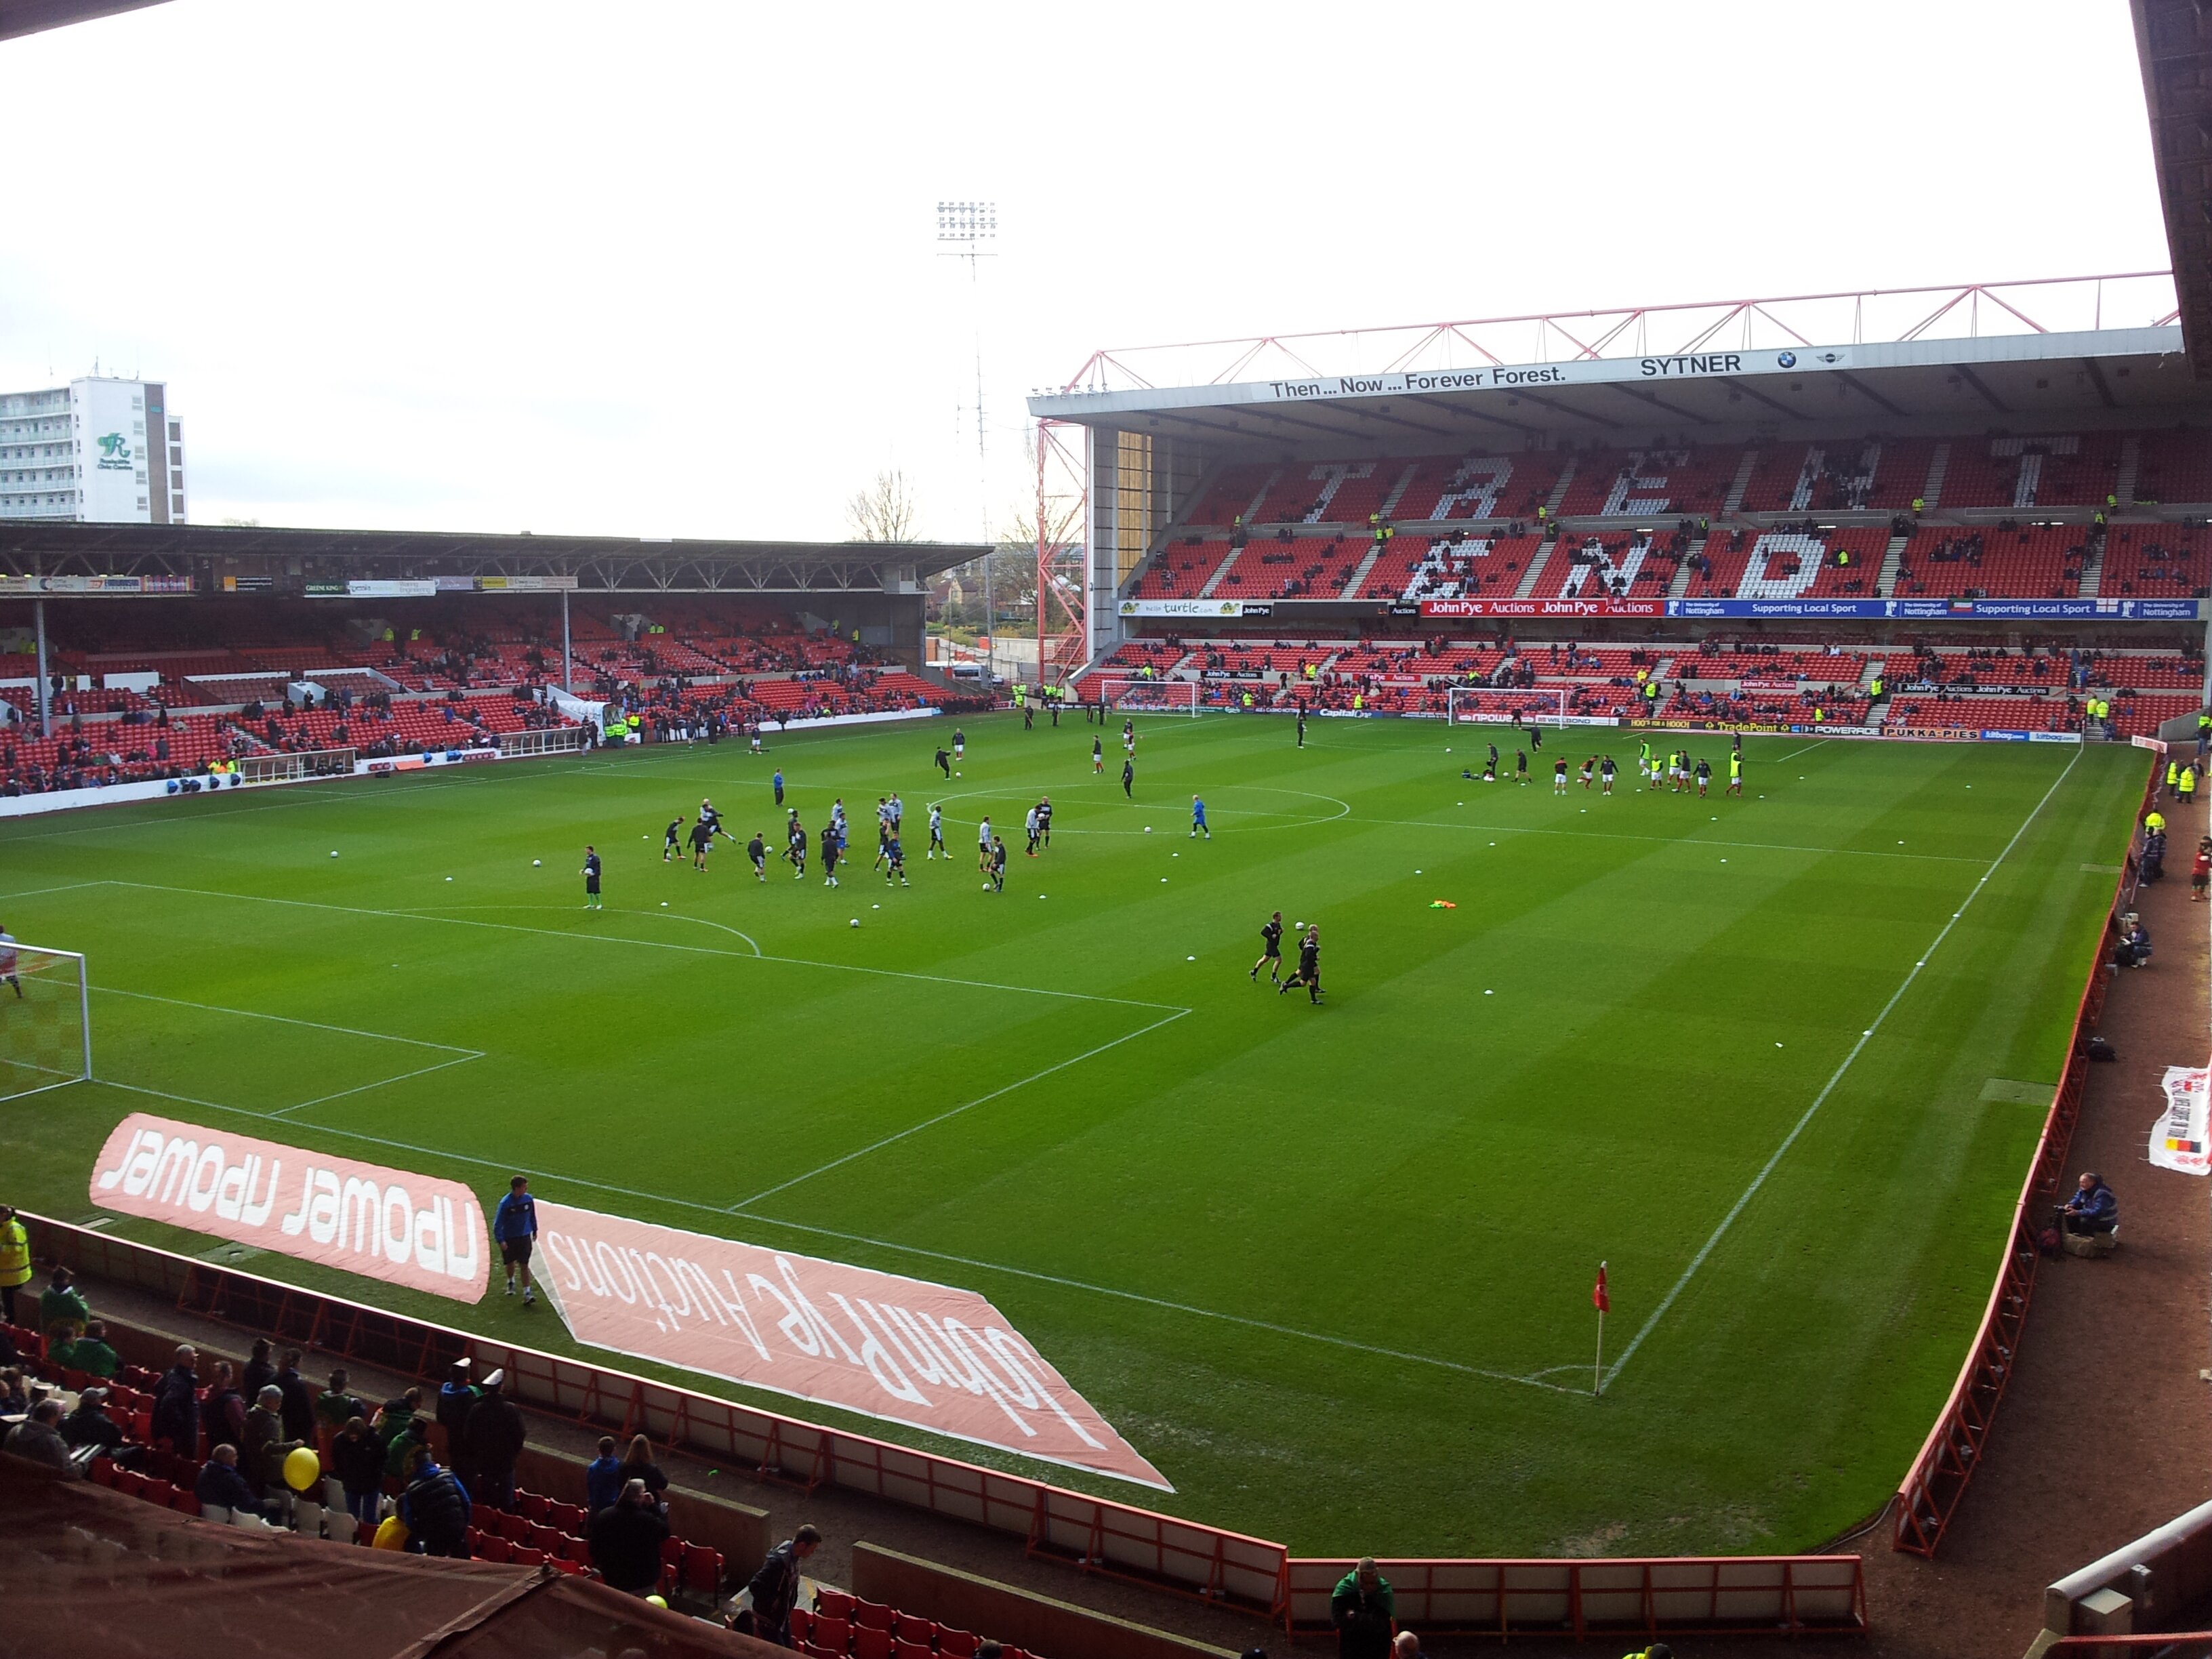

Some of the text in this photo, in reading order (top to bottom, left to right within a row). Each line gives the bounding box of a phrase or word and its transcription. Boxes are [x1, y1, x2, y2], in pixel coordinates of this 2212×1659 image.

[1641, 354, 1742, 377] SYTNER
[1406, 373, 1483, 390] Forever
[1492, 365, 1566, 385] Forest.
[1391, 606, 1416, 615] Auctions
[1429, 601, 1459, 613] John
[1461, 602, 1483, 616] Pye
[1488, 601, 1536, 614] Auctions
[1541, 601, 1572, 613] John
[1574, 602, 1599, 616] Pye
[1685, 607, 1725, 616] Nottingham
[1752, 603, 1857, 615] Supporting Local Sport
[1904, 607, 1948, 617] Nottingham
[1975, 603, 2091, 615] Supporting Local Sport
[2143, 608, 2191, 617] Nottingham
[1997, 686, 2012, 694] Pye
[2016, 686, 2047, 694] Auctions
[1319, 708, 1355, 718] Capital
[1472, 713, 1514, 722] npowe
[1666, 720, 1690, 729] HOOCH
[1717, 721, 1778, 733] TradePoint
[1814, 725, 1881, 735] POWERADE
[1985, 731, 2025, 740] kitbag.com
[2035, 733, 2075, 741] kitbag.com
[97, 1128, 281, 1227] npower
[281, 1166, 478, 1281] npower
[547, 1230, 1108, 1450] John Pye Auctions
